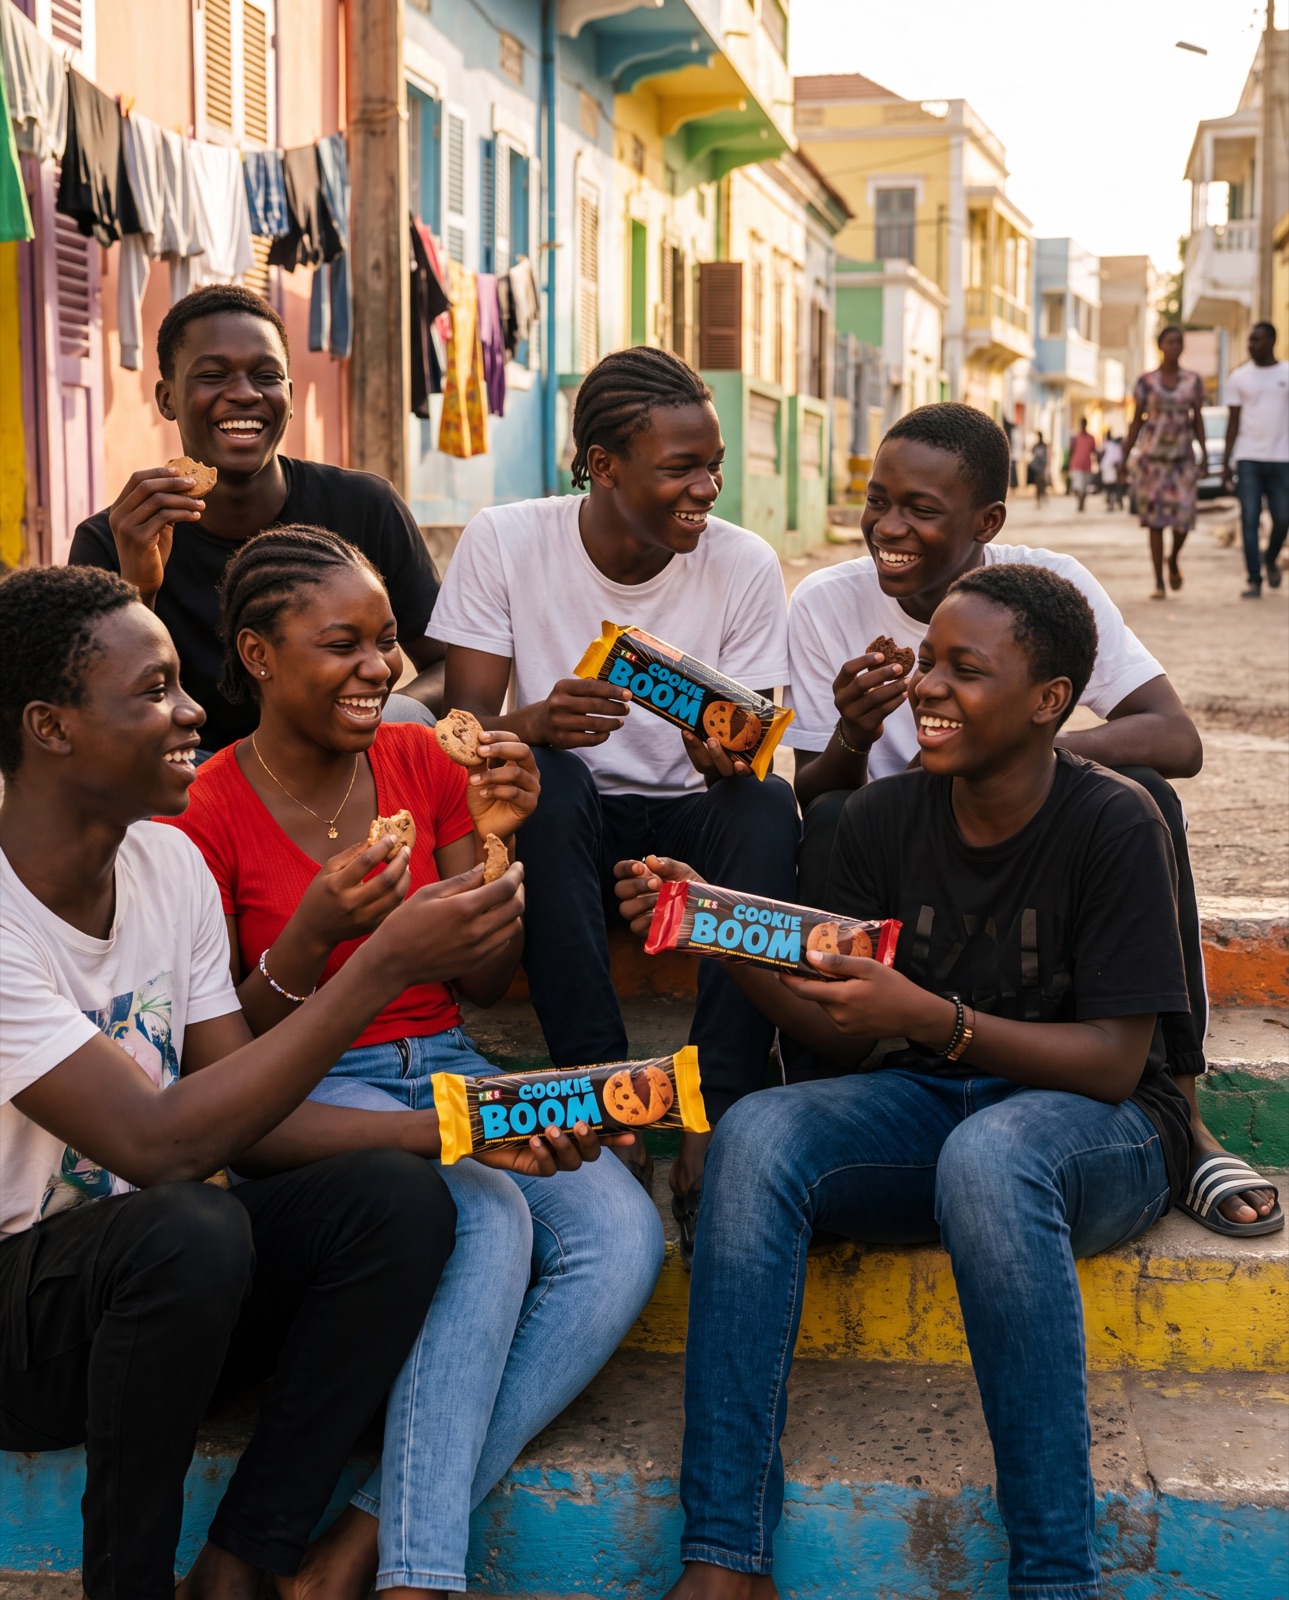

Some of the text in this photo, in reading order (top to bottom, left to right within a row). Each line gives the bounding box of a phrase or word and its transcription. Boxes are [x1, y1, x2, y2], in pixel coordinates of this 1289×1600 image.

[608, 658, 704, 727] BOOM
[648, 662, 706, 701] COOKIE
[690, 912, 801, 962] BOOM
[733, 904, 802, 931] COOKIE
[518, 1075, 594, 1101] COOKIE
[479, 1093, 603, 1140] BOOM
